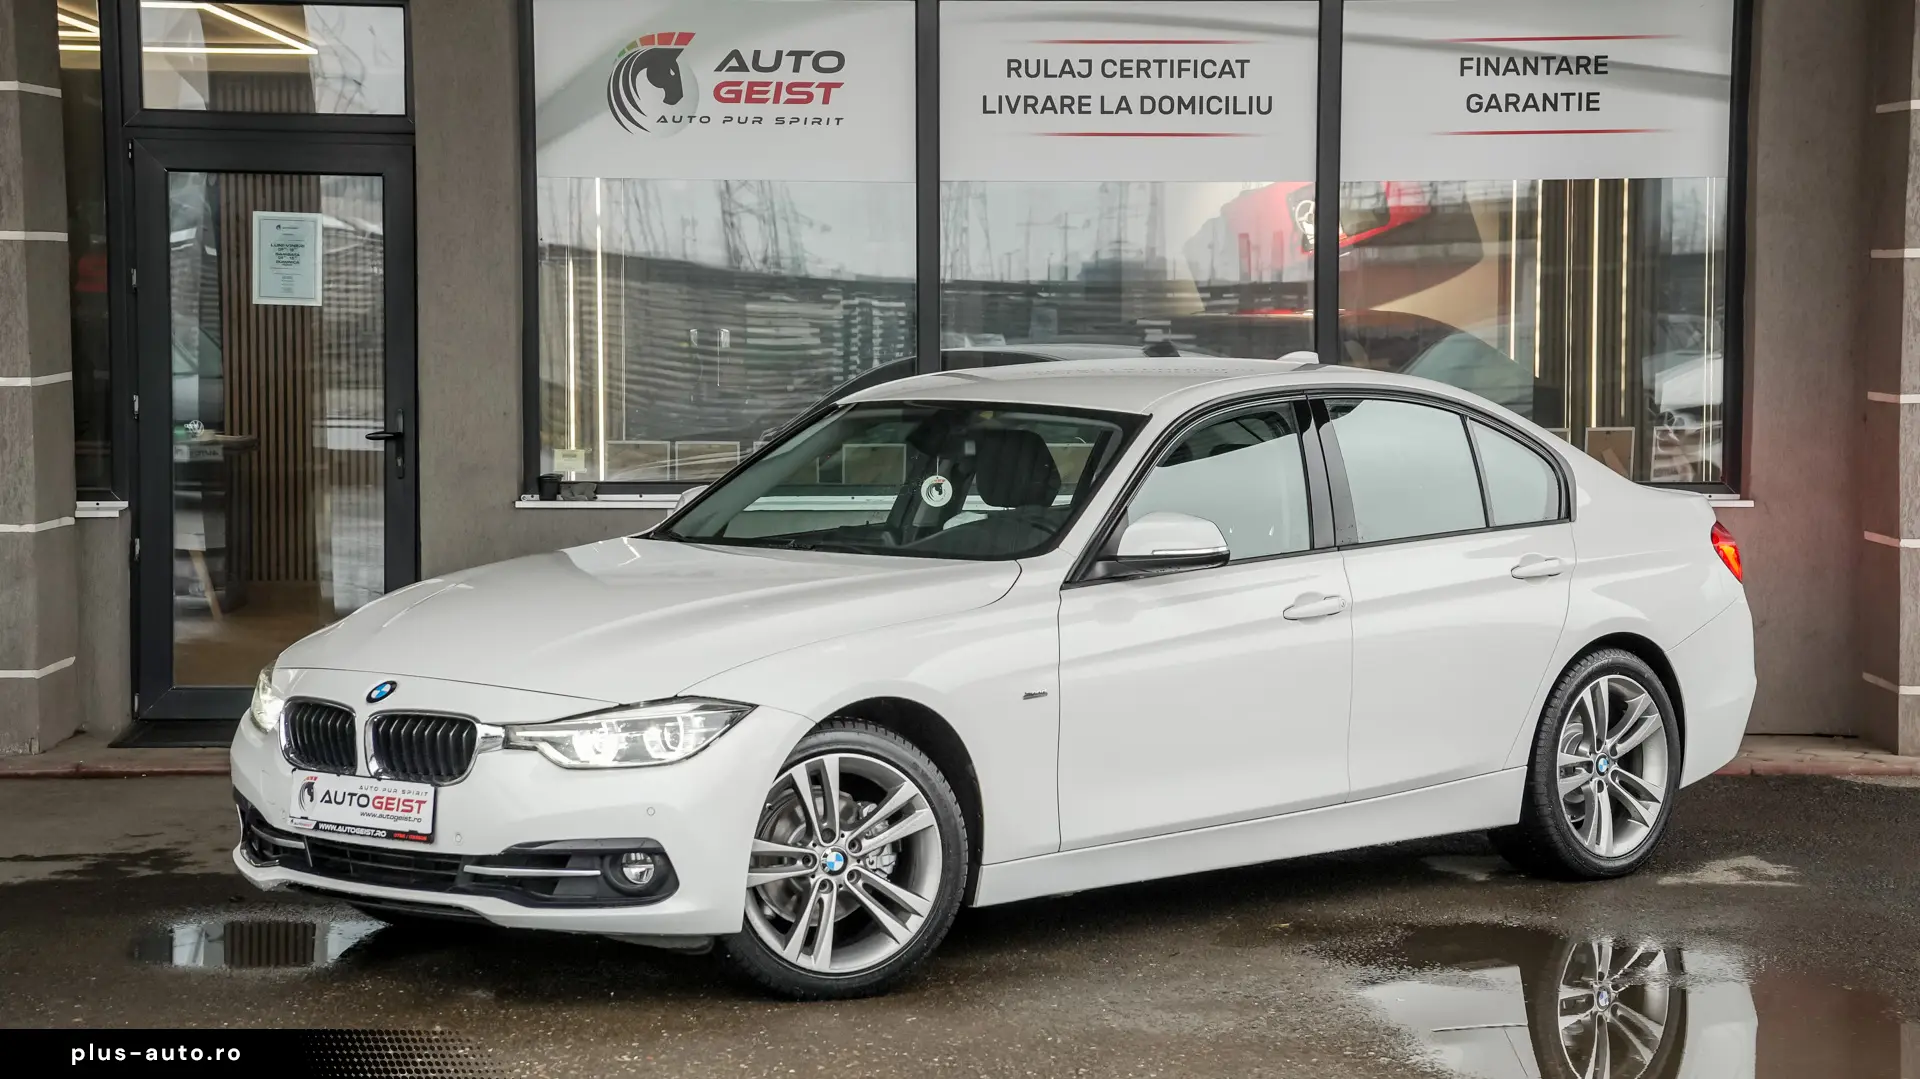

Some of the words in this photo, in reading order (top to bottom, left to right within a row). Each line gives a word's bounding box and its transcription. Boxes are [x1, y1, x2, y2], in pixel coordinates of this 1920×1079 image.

[713, 48, 846, 74] AUTO
[1006, 58, 1094, 79] RULAJ
[1100, 58, 1251, 79] CERTIFICAT
[1459, 55, 1609, 77] FINANTARE
[712, 80, 846, 105] GEIST
[1466, 91, 1601, 114] GARANTIE
[981, 94, 1093, 115] LIVRARE
[1099, 95, 1133, 115] LA
[1139, 95, 1273, 116] DOMICILIU
[655, 114, 712, 125] AUTO
[722, 115, 764, 126] PUR
[774, 116, 845, 127] SPIRIT
[320, 789, 427, 814] AUTOGEIST
[401, 789, 429, 797] SPIRIT
[360, 811, 422, 824] www.autogeist.ro
[318, 822, 387, 837] WWW.AUTOGEIST.RO
